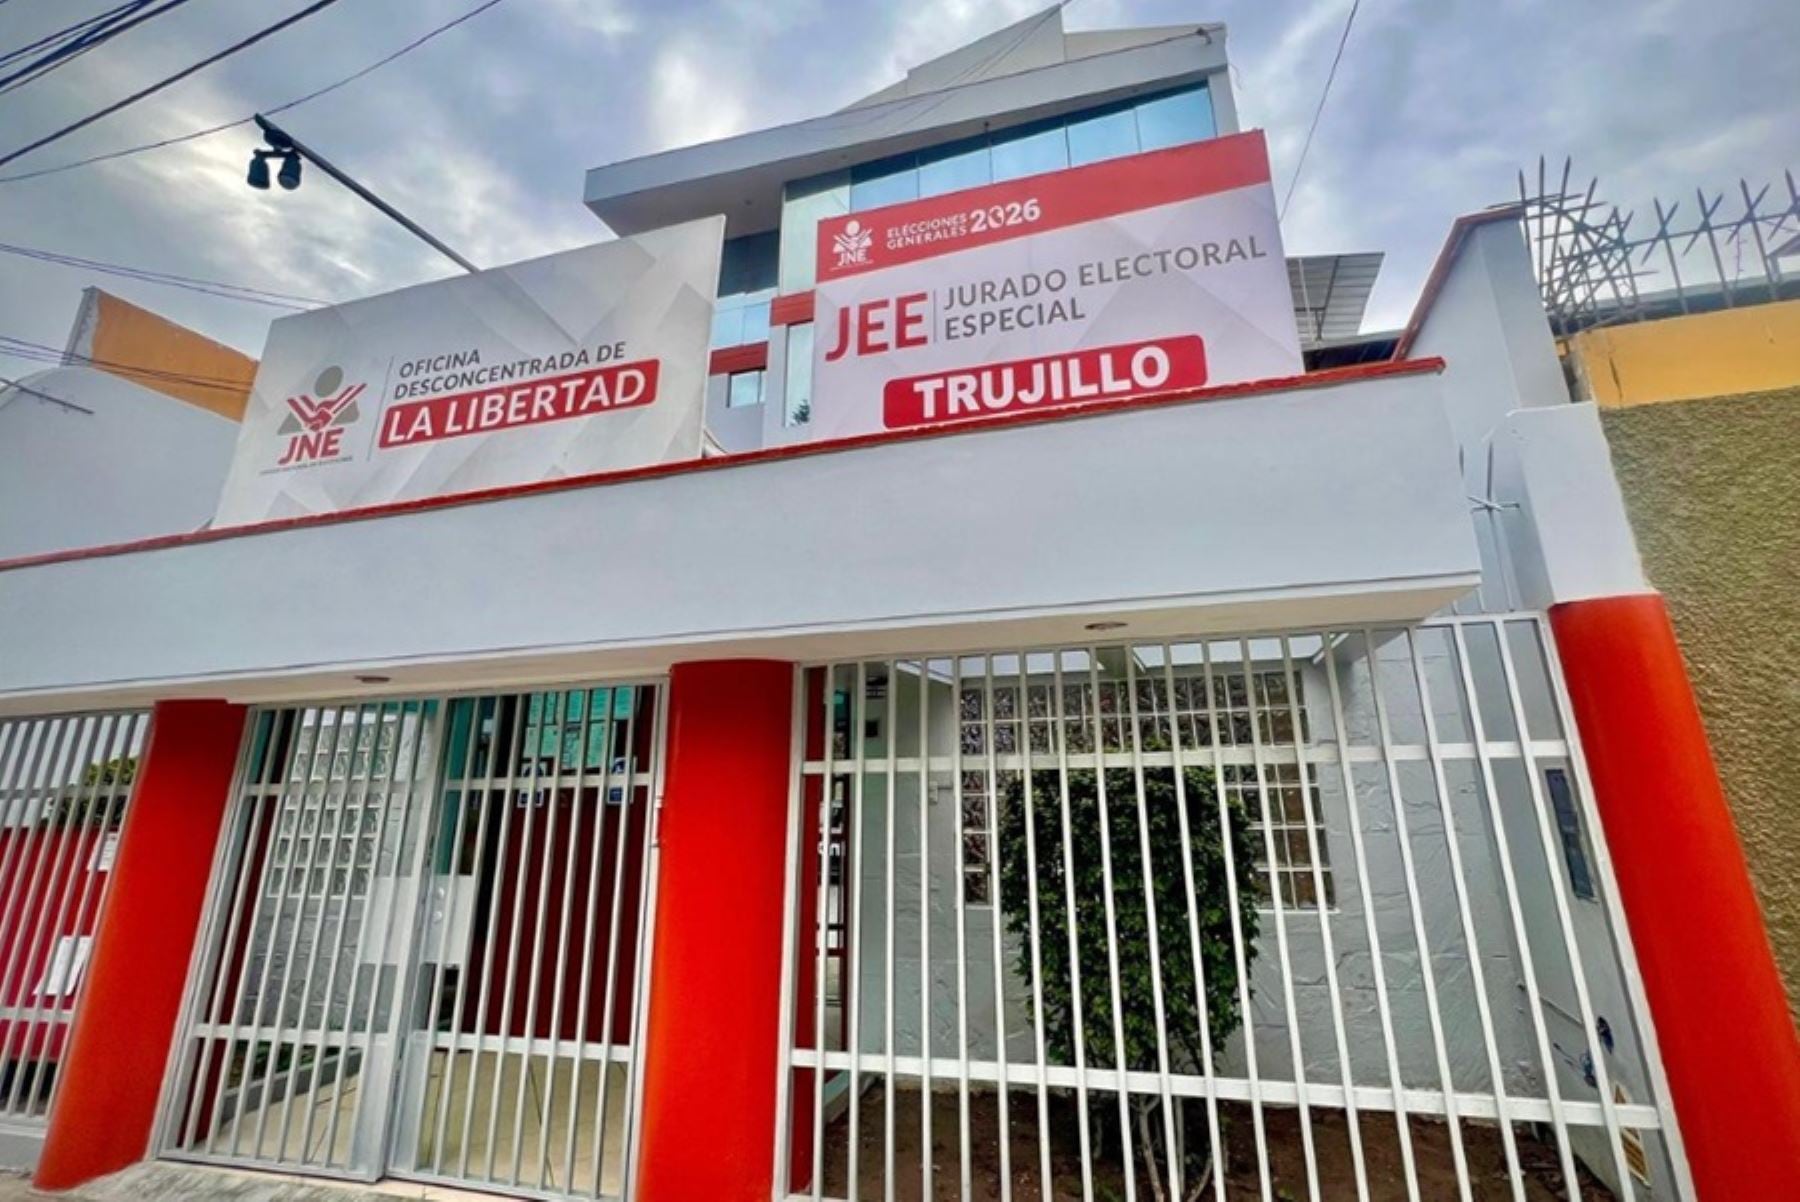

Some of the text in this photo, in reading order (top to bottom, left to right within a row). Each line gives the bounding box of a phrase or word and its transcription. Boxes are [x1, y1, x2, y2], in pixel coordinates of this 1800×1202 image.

[887, 213, 967, 239] ELECCIONES
[970, 198, 1041, 233] 2026
[887, 225, 968, 250] GENERALES
[838, 249, 867, 267] JNE
[943, 235, 1267, 311] JURADO ELECTORAL
[825, 292, 929, 362] JEE
[945, 298, 1086, 341] ESPECIAL
[394, 341, 626, 400] DESCONCENTRADA DE
[400, 349, 480, 378] OFICINA
[913, 346, 1170, 418] TRUJILLO
[387, 368, 646, 443] LA LIBERTAD
[277, 427, 345, 465] JNE
